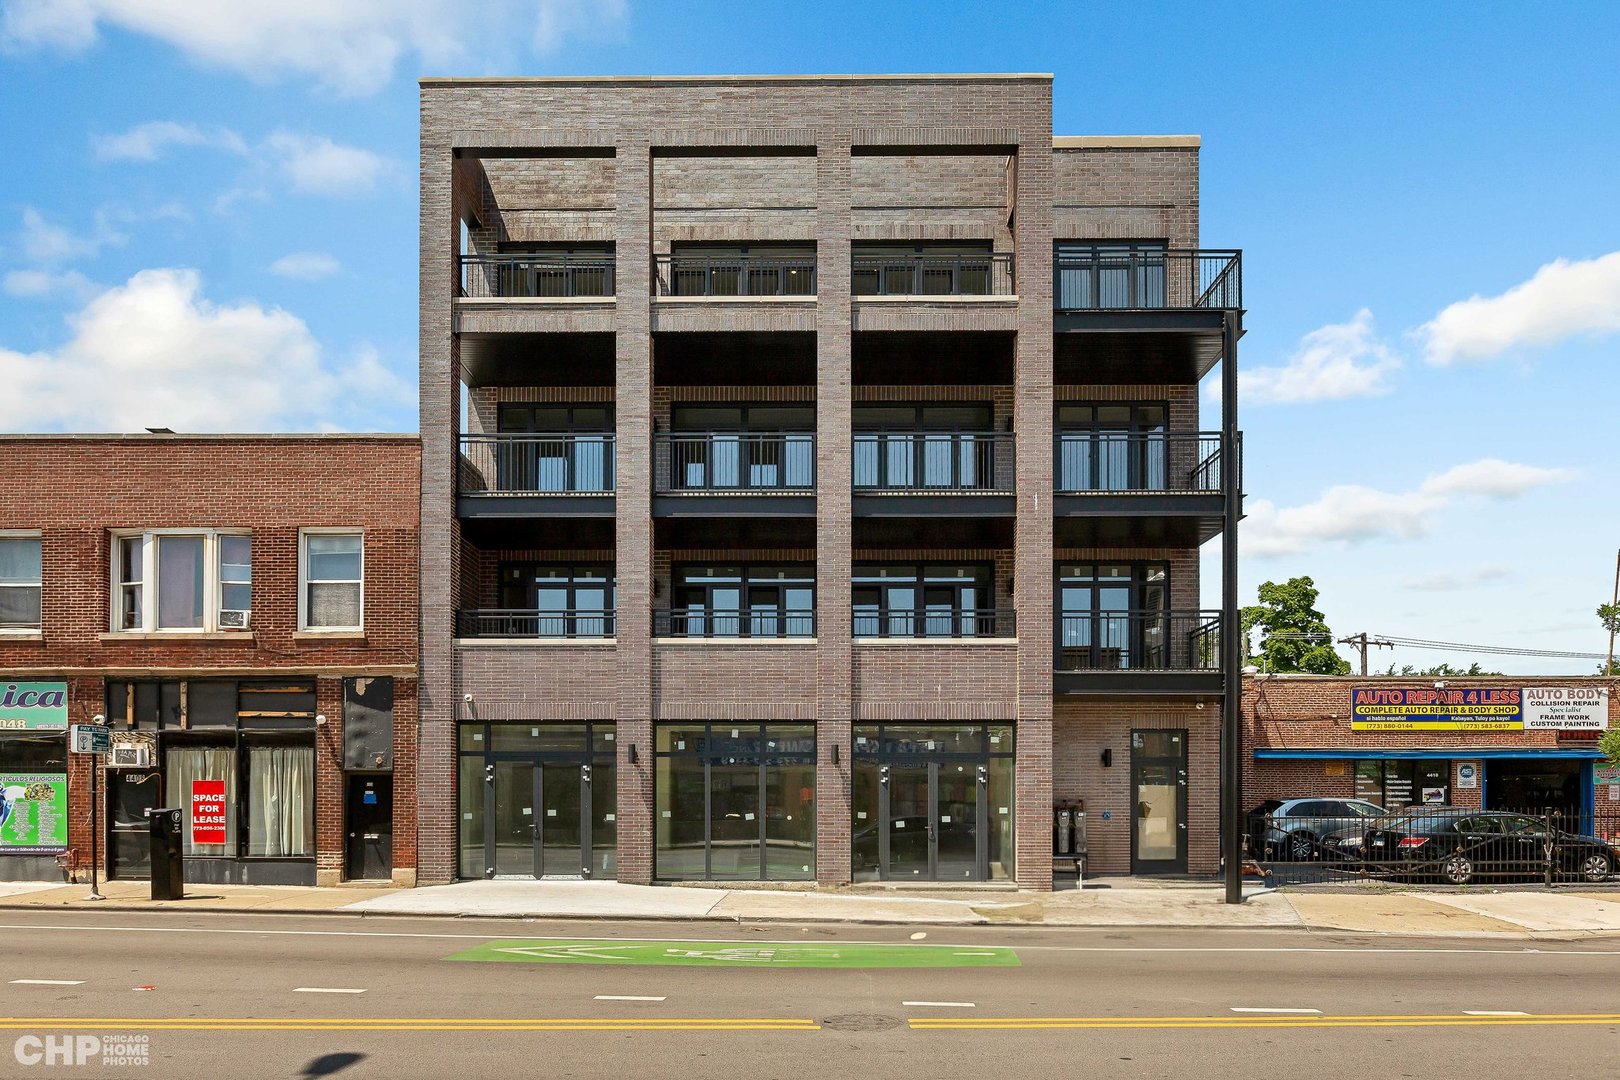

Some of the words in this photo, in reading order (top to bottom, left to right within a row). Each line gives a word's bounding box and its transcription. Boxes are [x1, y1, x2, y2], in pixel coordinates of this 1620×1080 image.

[1355, 690, 1403, 704] AUTO
[1406, 690, 1464, 704] REPAIR
[1466, 690, 1478, 704] 4
[1481, 690, 1520, 704] LESS
[1527, 689, 1563, 700] AUTO
[1567, 689, 1604, 700] BODY
[1359, 706, 1403, 714] COMPLETE
[1404, 706, 1429, 714] AUTO
[1431, 706, 1458, 714] REPAIR
[1468, 706, 1492, 714] BODY
[1493, 706, 1517, 714] SHOP
[193, 794, 225, 802] SPACE
